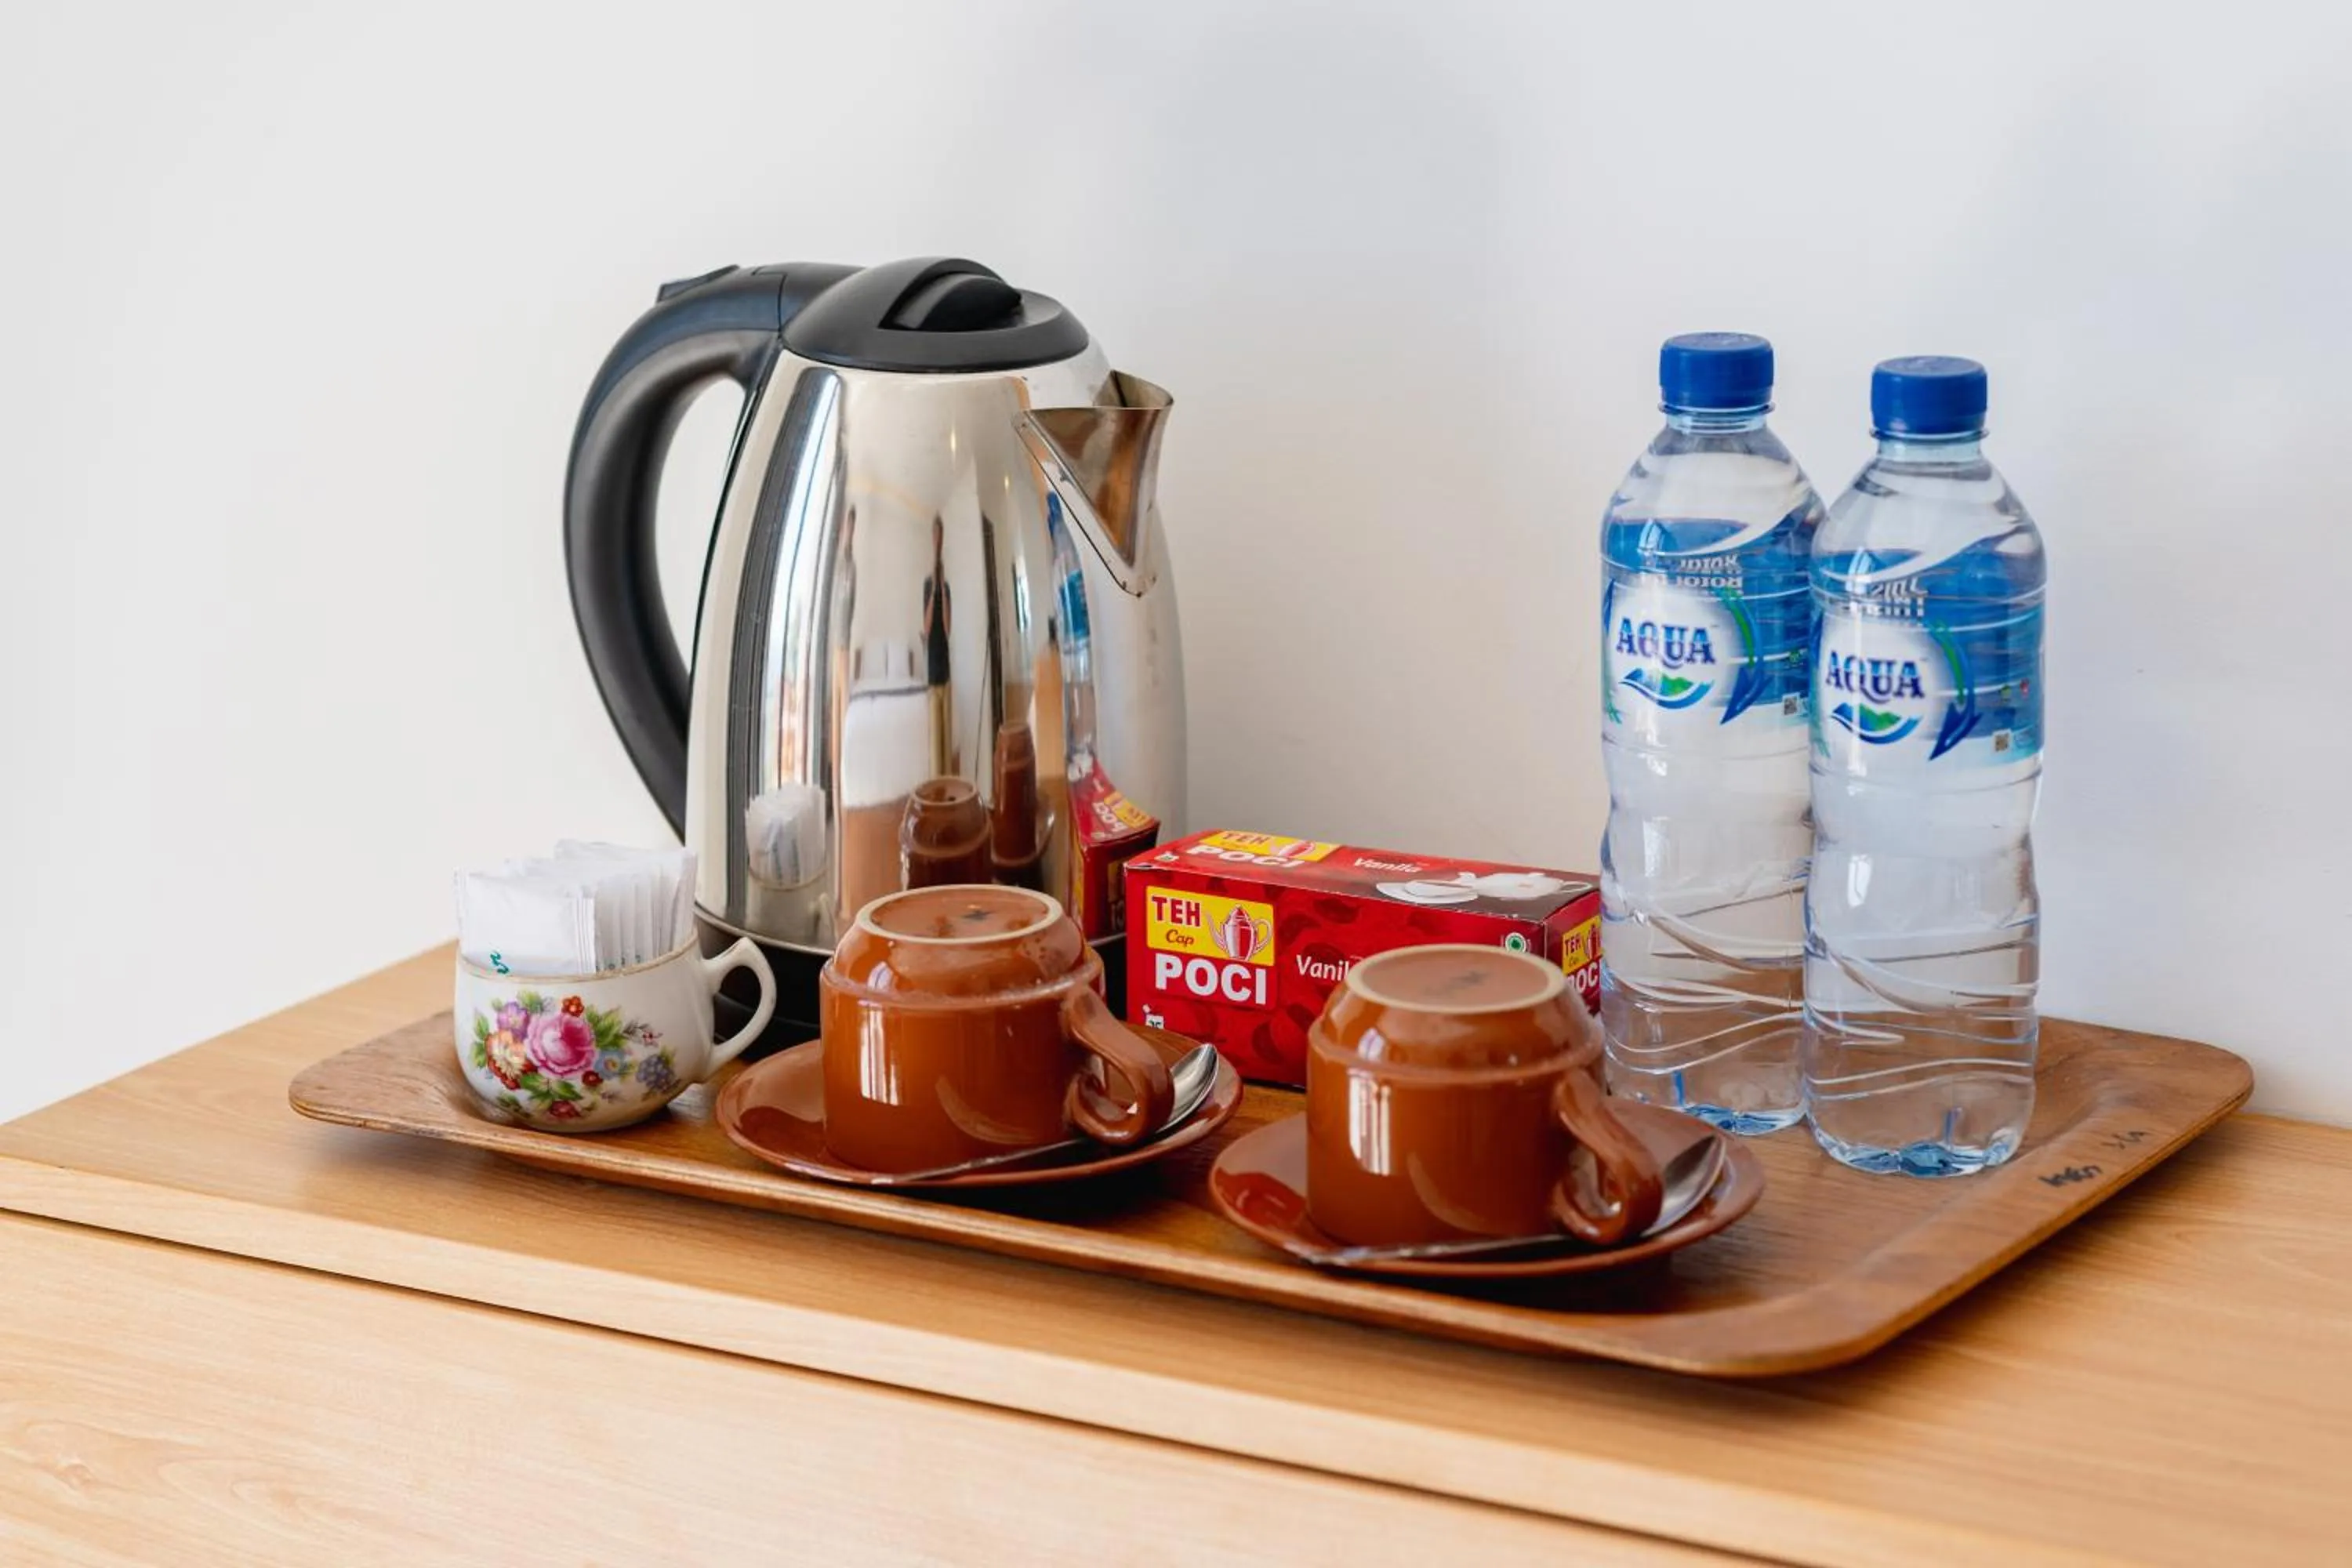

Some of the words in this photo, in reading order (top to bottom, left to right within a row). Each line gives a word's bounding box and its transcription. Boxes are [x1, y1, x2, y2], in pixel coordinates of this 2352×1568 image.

[1616, 616, 1715, 669] AQUA
[1826, 650, 1925, 704] AQUA
[1186, 845, 1305, 868] POCI
[1152, 895, 1201, 927] TEH
[1166, 929, 1195, 948] Cap
[1155, 953, 1267, 1005] POCI
[1296, 954, 1350, 982] Vanil
